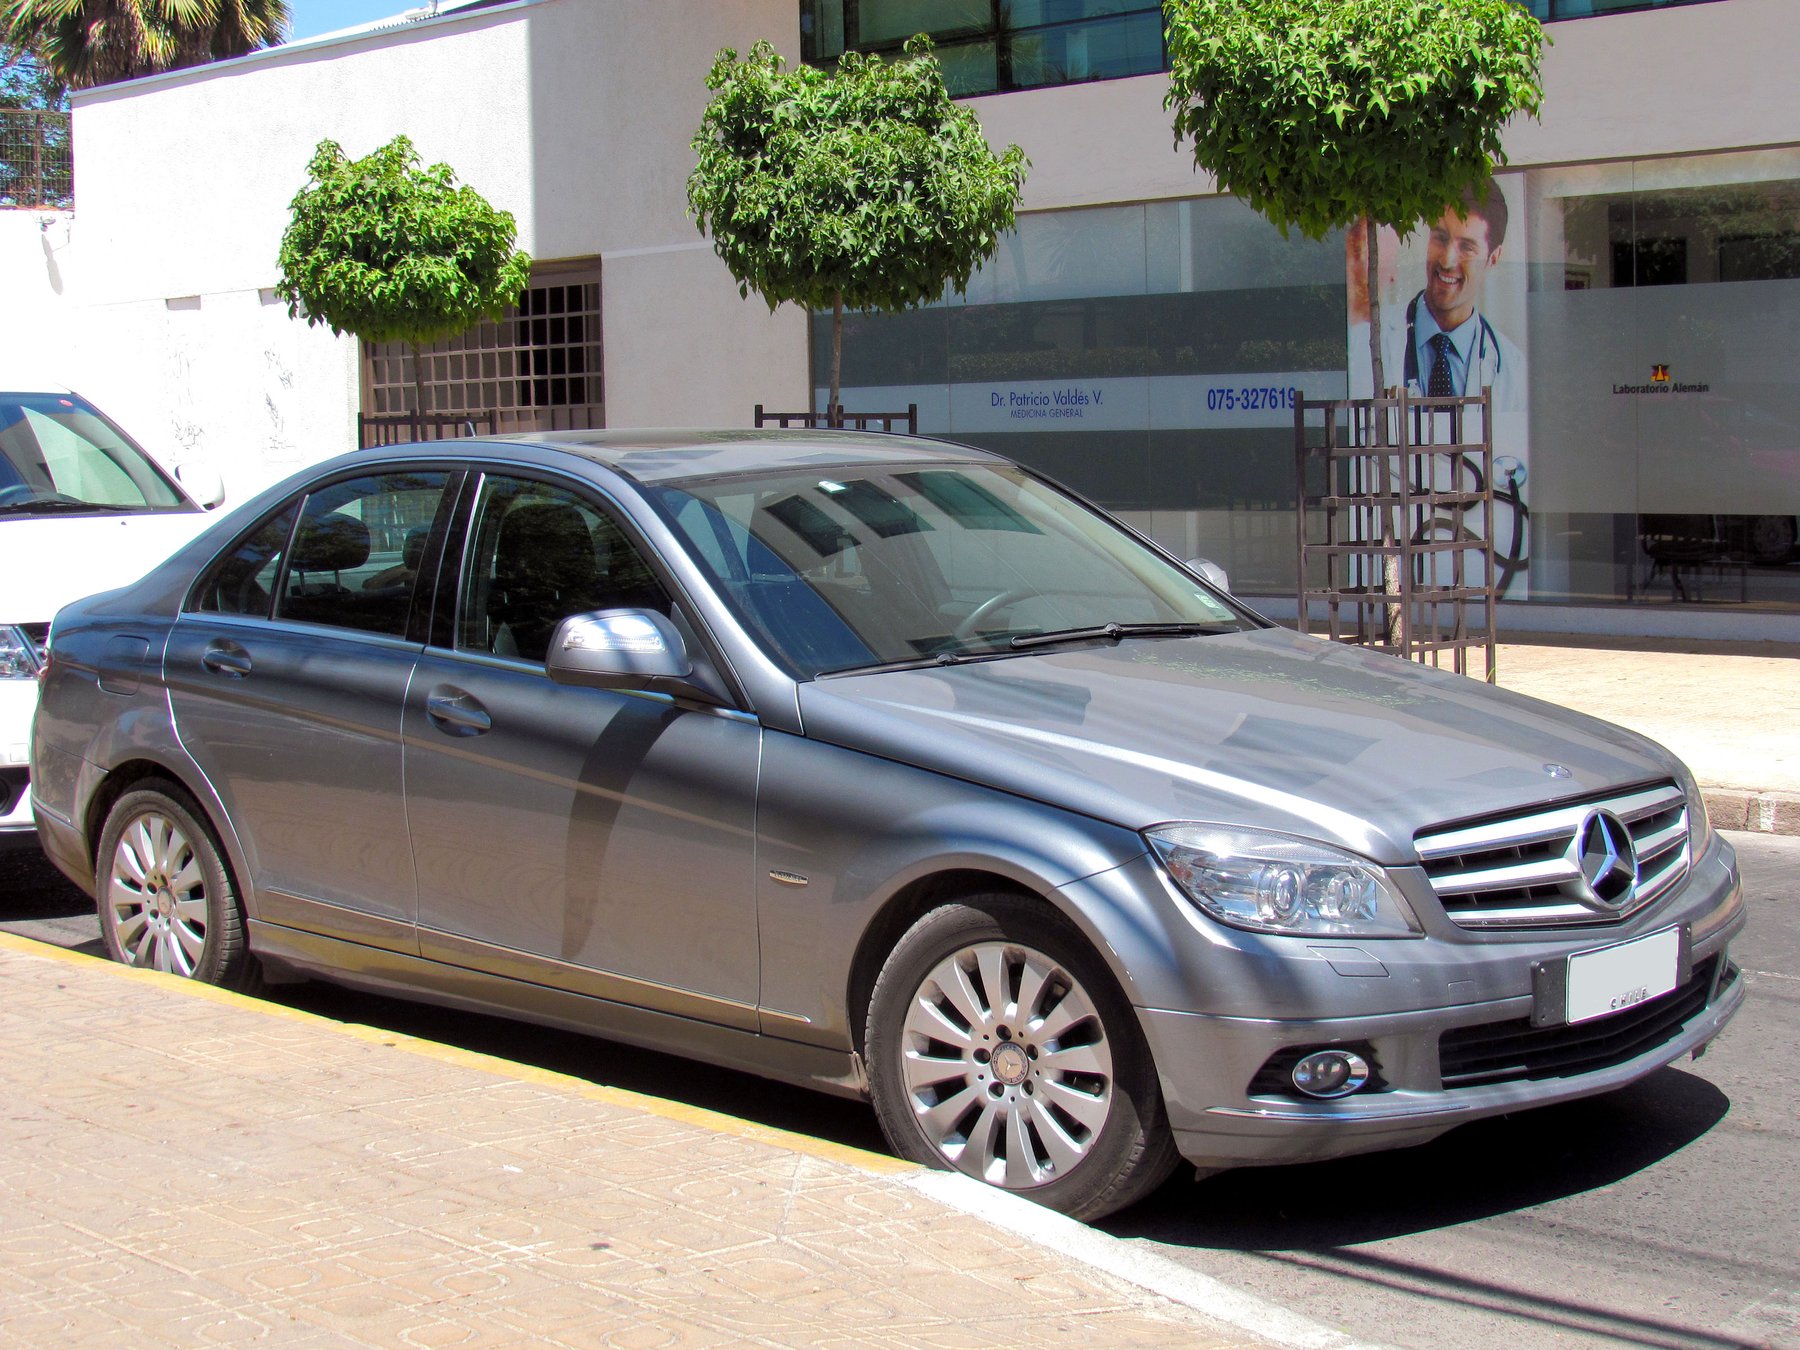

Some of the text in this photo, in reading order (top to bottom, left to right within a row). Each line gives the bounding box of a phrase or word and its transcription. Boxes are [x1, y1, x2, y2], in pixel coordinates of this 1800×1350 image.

[991, 388, 1103, 407] Dr. Patricio Valdés V.
[1613, 382, 1709, 394] Laboratorio Alemán
[1207, 387, 1296, 410] 075-327619
[1010, 408, 1083, 419] MEDICINA GENERAL
[1610, 986, 1647, 1008] CHILE
